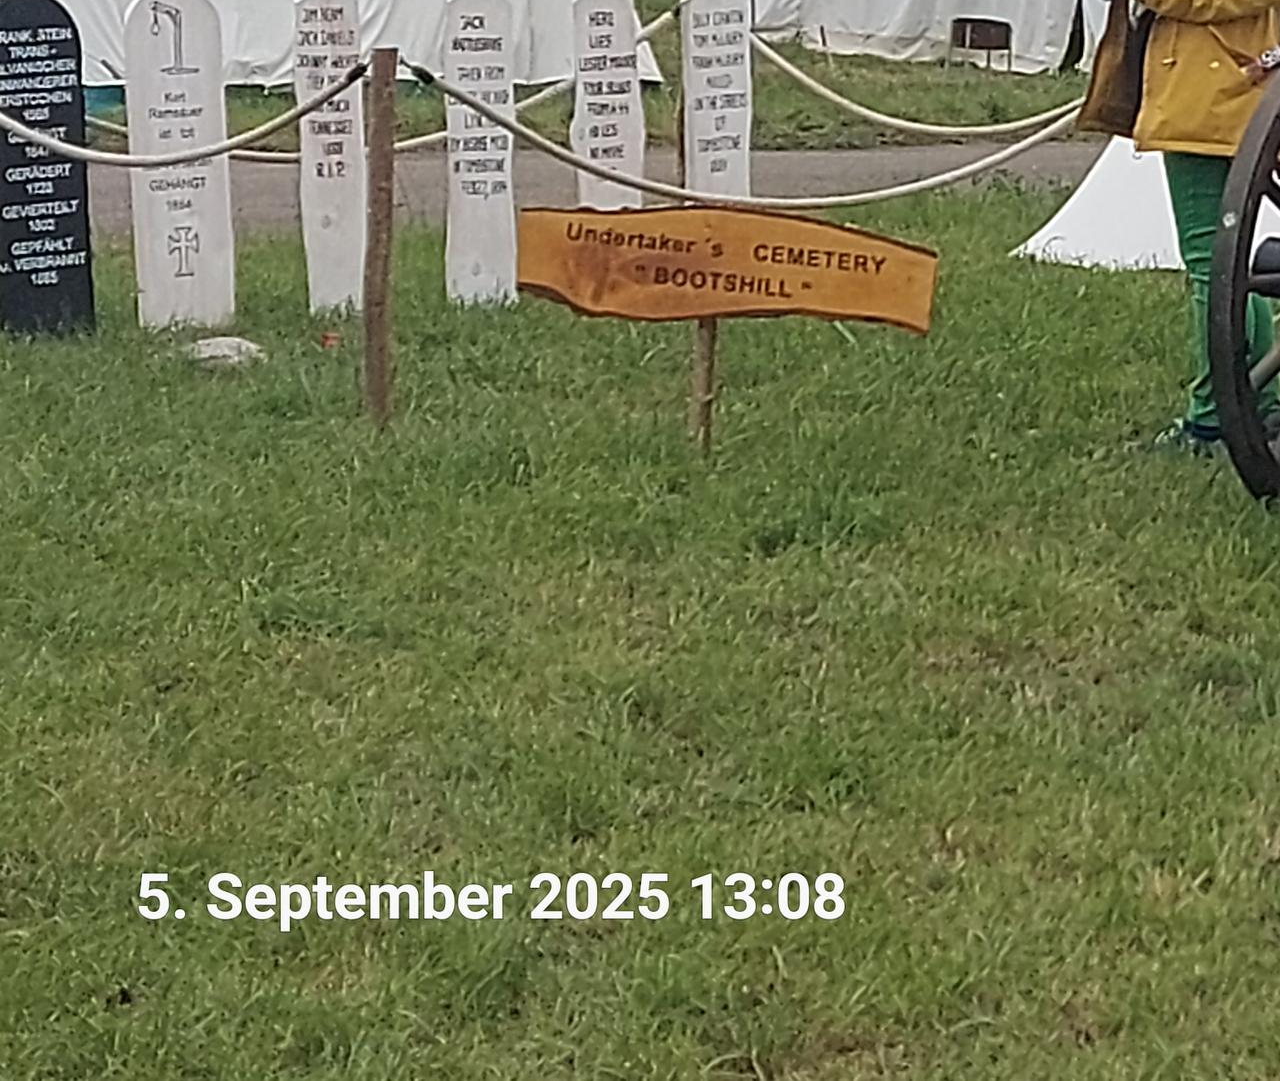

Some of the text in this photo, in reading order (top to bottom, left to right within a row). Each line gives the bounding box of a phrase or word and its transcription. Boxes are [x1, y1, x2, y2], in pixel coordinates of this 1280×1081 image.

[589, 11, 614, 27] HERE
[589, 34, 612, 49] LIES
[0, 91, 72, 107] ERSTOCHEN
[753, 244, 887, 275] CEMETERY
